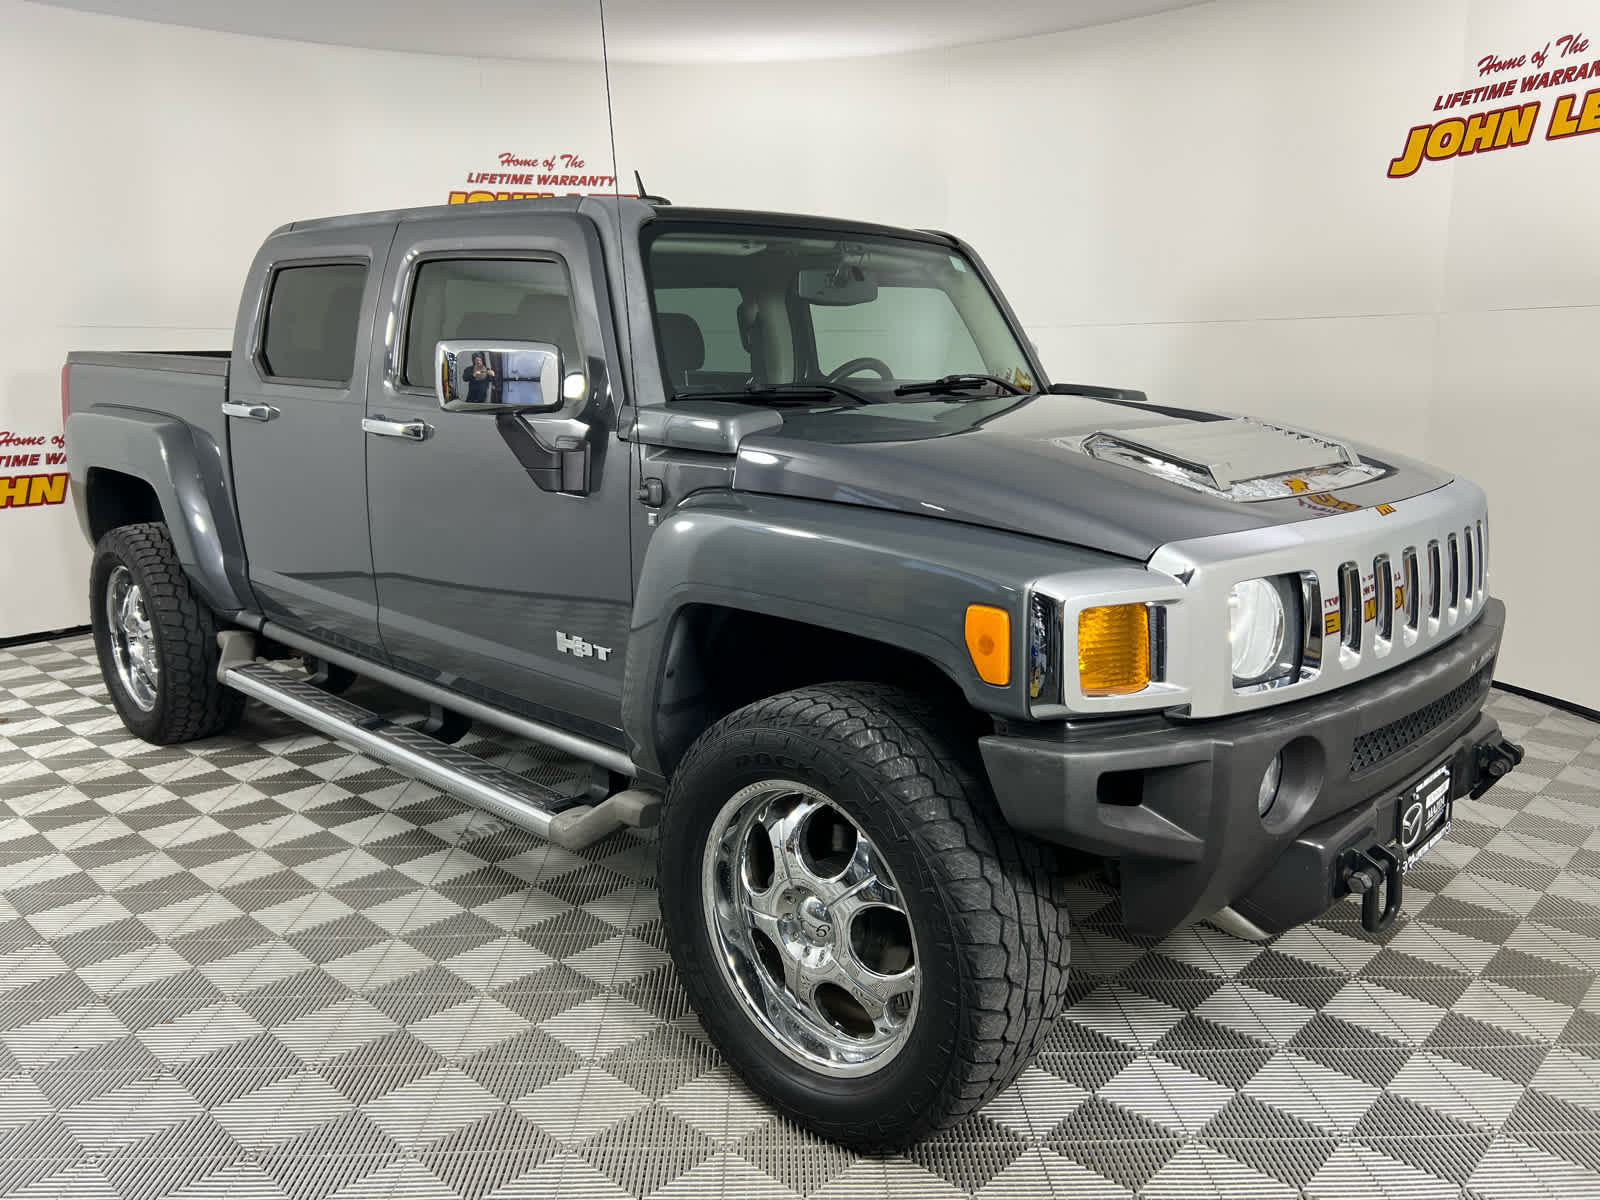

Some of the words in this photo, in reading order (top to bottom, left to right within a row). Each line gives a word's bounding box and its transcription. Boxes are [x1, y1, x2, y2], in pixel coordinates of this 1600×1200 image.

[1477, 54, 1527, 77] Home
[1531, 42, 1551, 69] of
[1555, 32, 1590, 58] The
[1433, 79, 1518, 111] LIFETIME
[1387, 101, 1541, 179] JOHN
[498, 152, 539, 167] Home
[543, 155, 556, 171] of
[560, 153, 585, 169] The
[467, 172, 534, 185] LIFETIME
[537, 173, 616, 186] WARRANTY
[0, 431, 46, 447] Home
[556, 631, 612, 661] H3T
